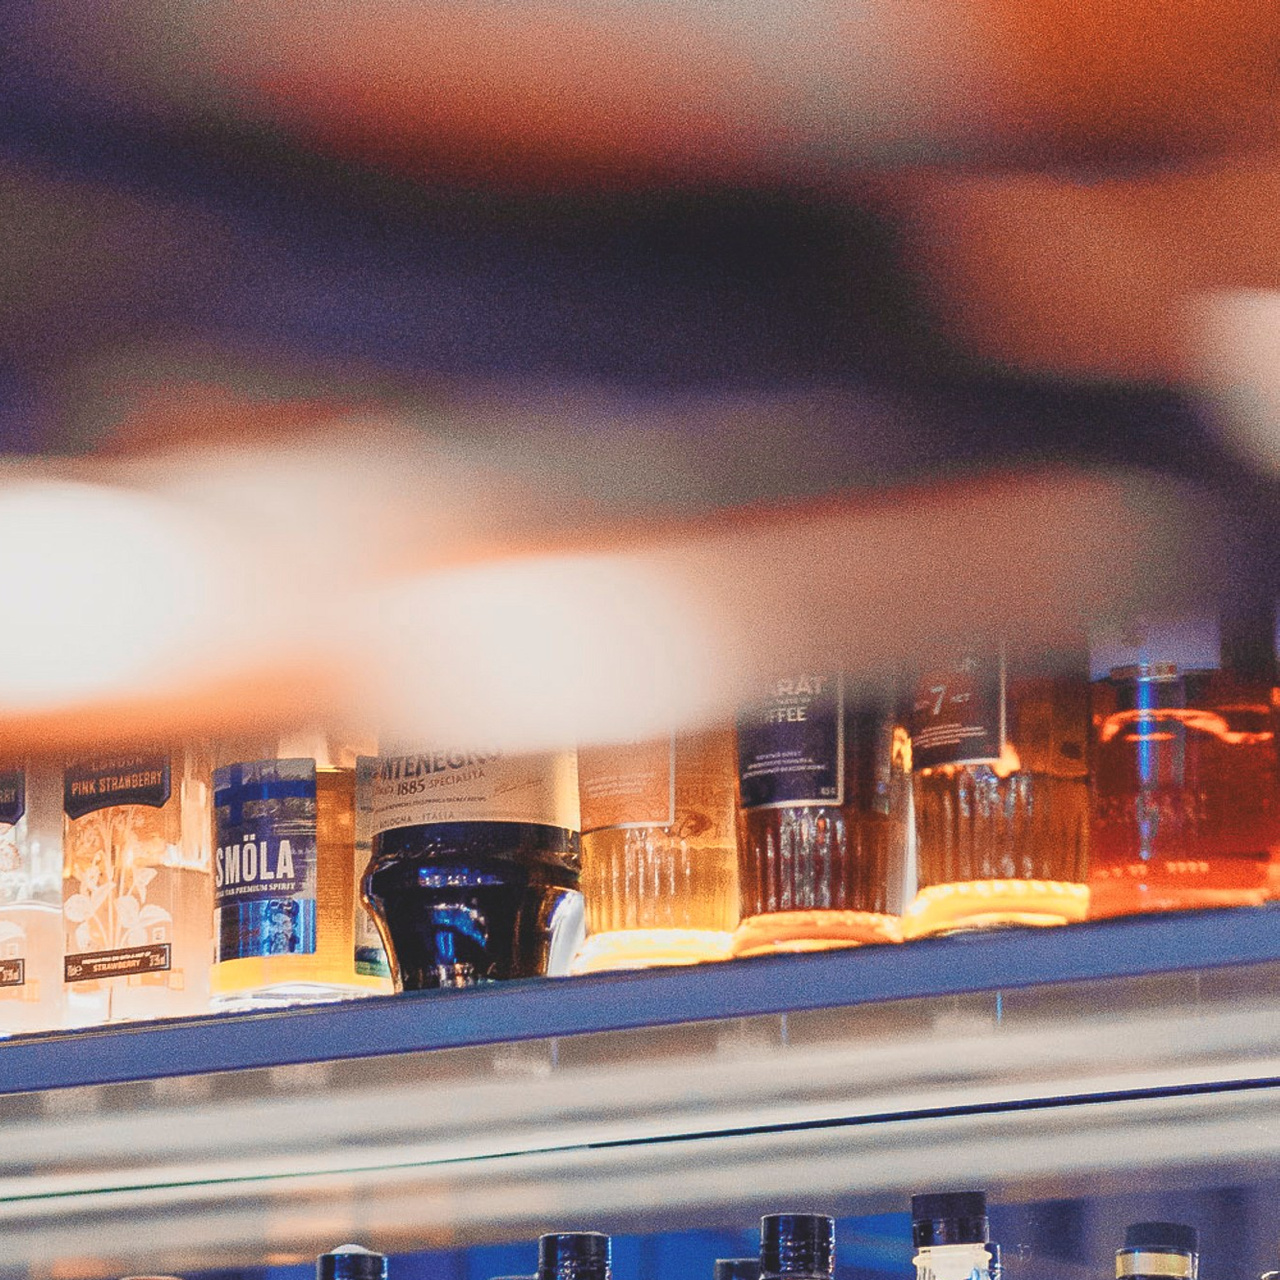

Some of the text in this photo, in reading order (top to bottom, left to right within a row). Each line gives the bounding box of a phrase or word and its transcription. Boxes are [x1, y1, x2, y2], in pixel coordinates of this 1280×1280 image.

[71, 770, 162, 796] PINK STRAWBERRY
[397, 779, 426, 795] 1885
[93, 958, 141, 973] STRAWBERRY
